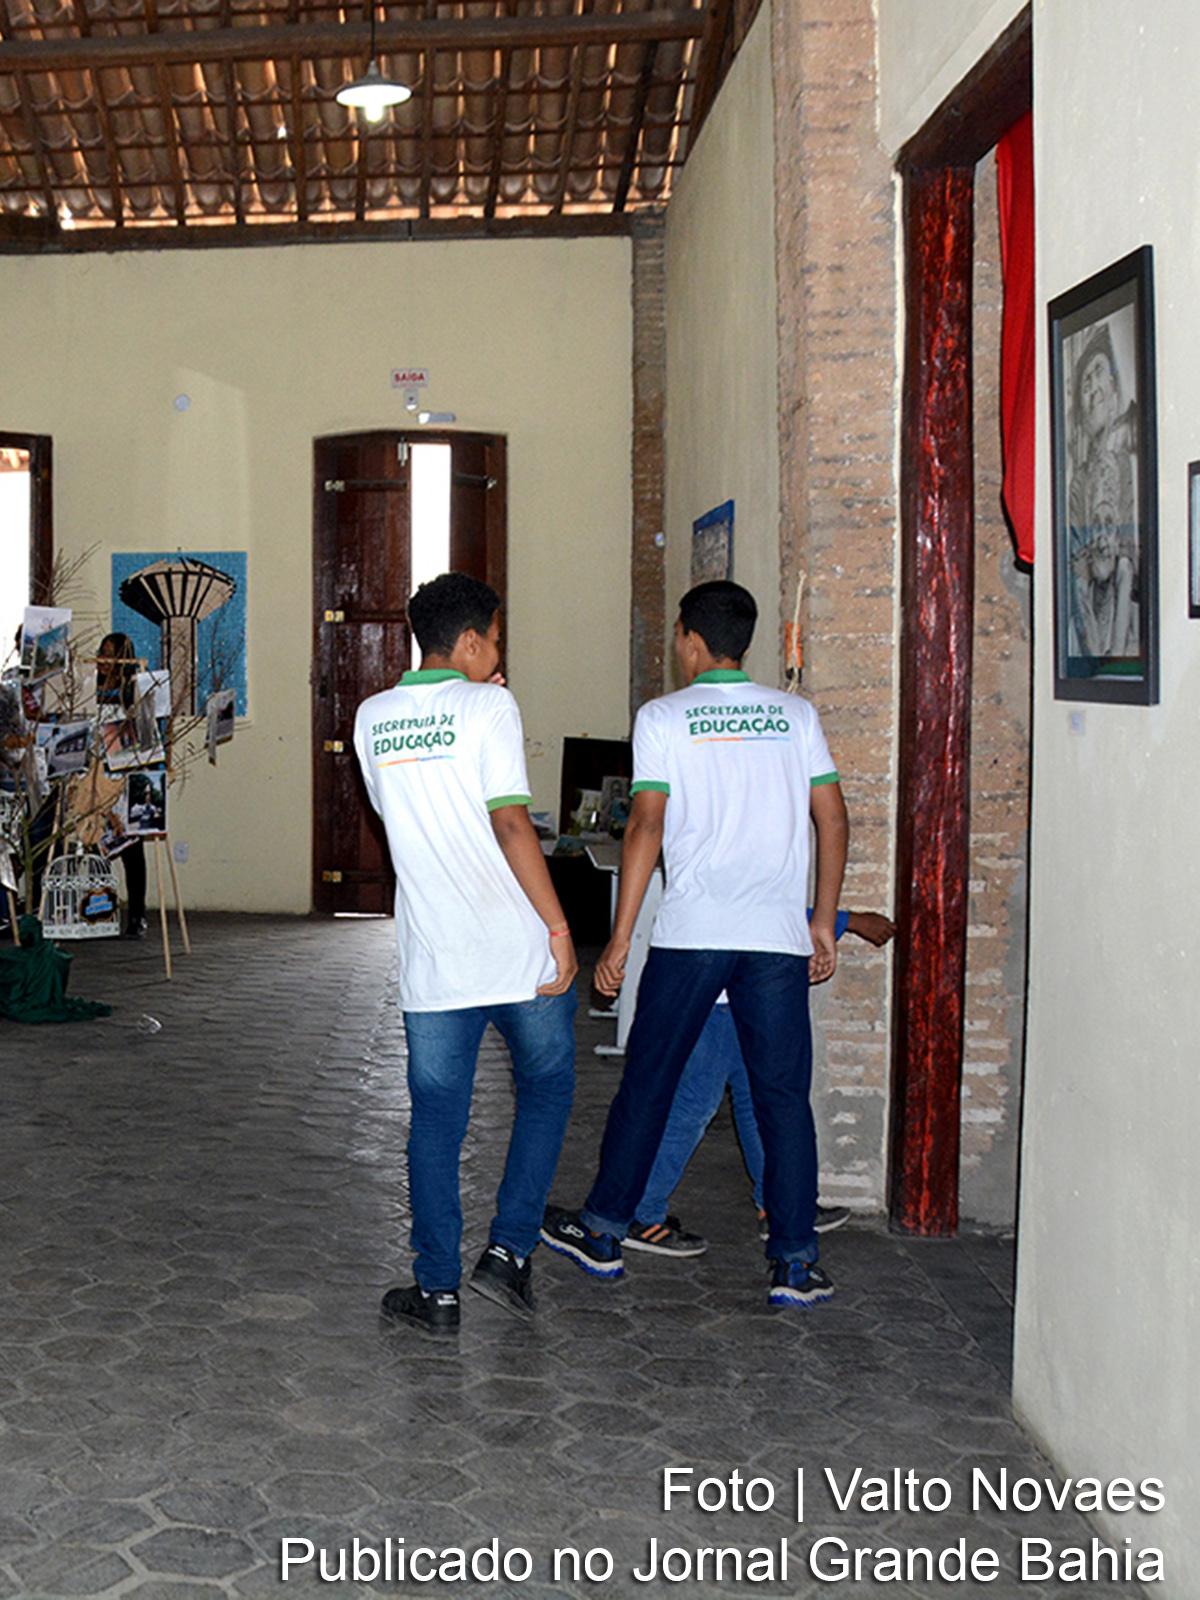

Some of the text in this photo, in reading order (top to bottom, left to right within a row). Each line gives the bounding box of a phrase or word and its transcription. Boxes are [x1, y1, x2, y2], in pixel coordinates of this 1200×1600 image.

[440, 713, 456, 726] DE
[685, 704, 784, 719] SECRETARIA DE
[689, 715, 790, 736] EDUCAÇÃO
[373, 727, 456, 756] EDUCAÇÃO
